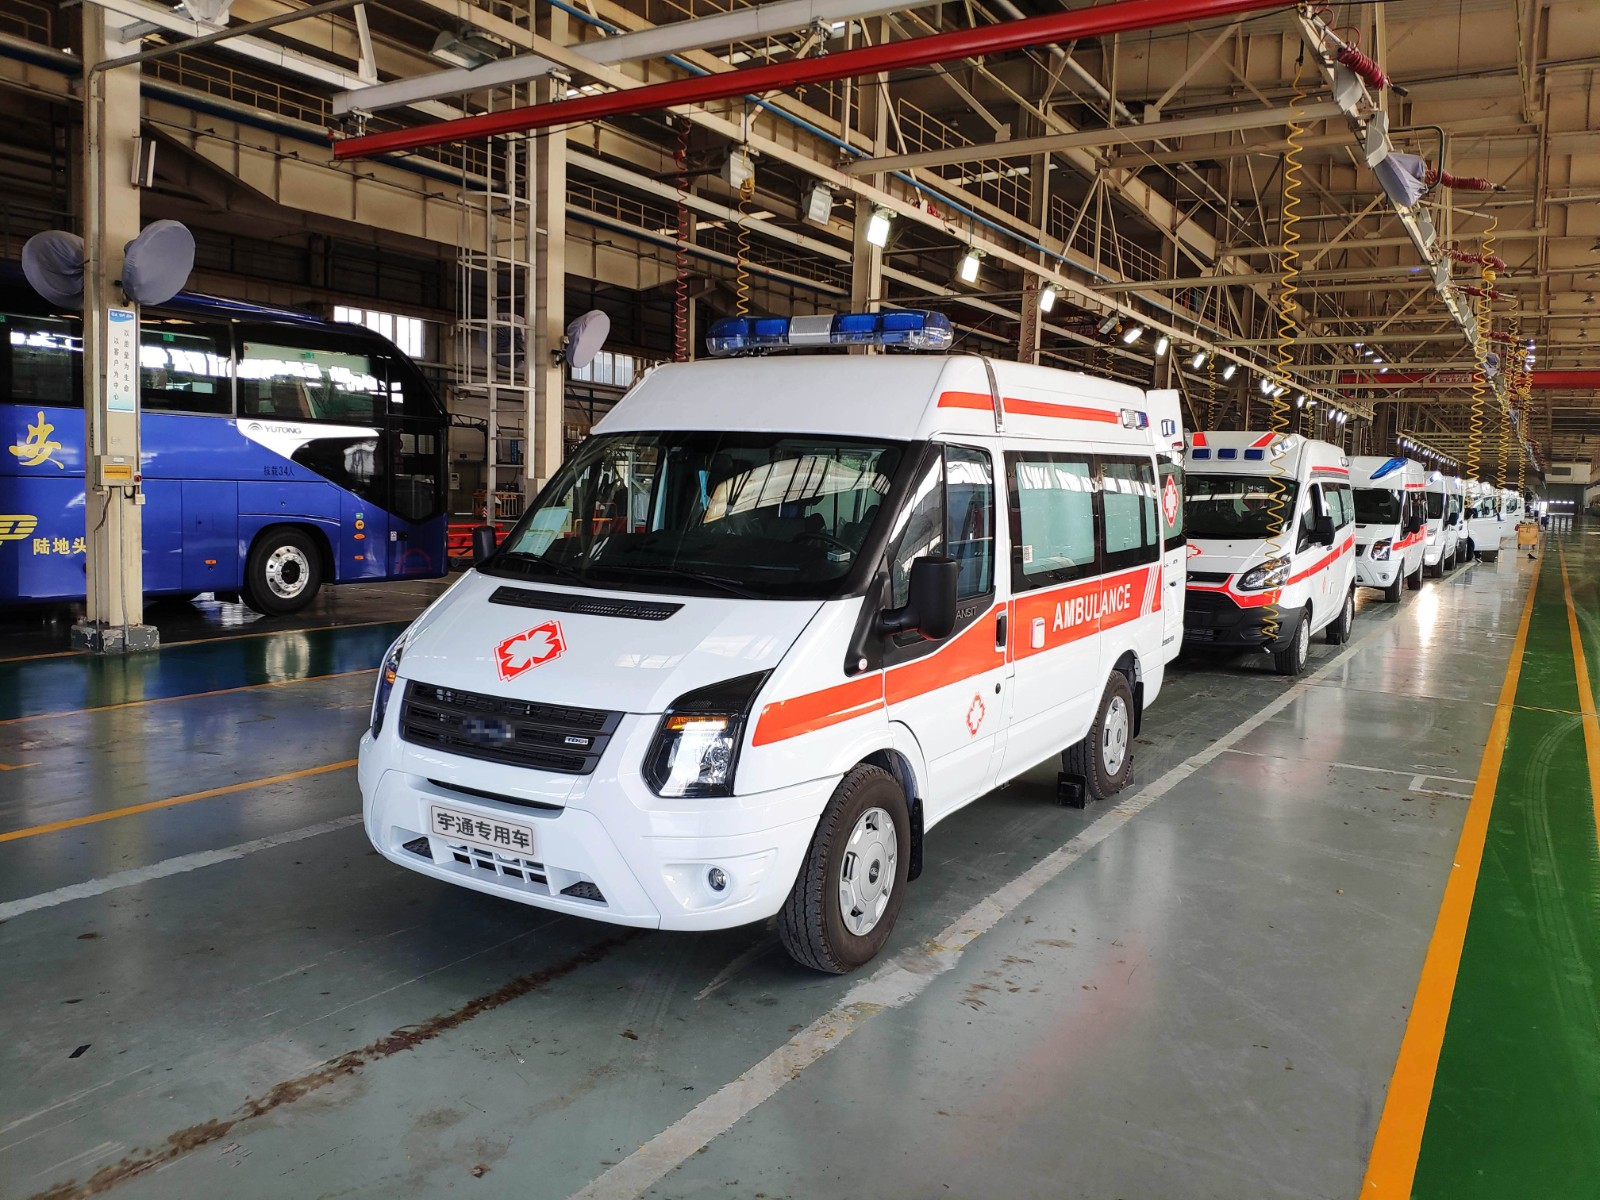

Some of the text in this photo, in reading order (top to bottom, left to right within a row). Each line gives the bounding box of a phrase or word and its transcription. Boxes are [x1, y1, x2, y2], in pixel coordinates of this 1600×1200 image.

[8, 410, 65, 470] 安
[264, 425, 302, 435] YUTONG
[1052, 583, 1131, 633] AMBULANCE
[437, 812, 530, 849] 宇通专用车
